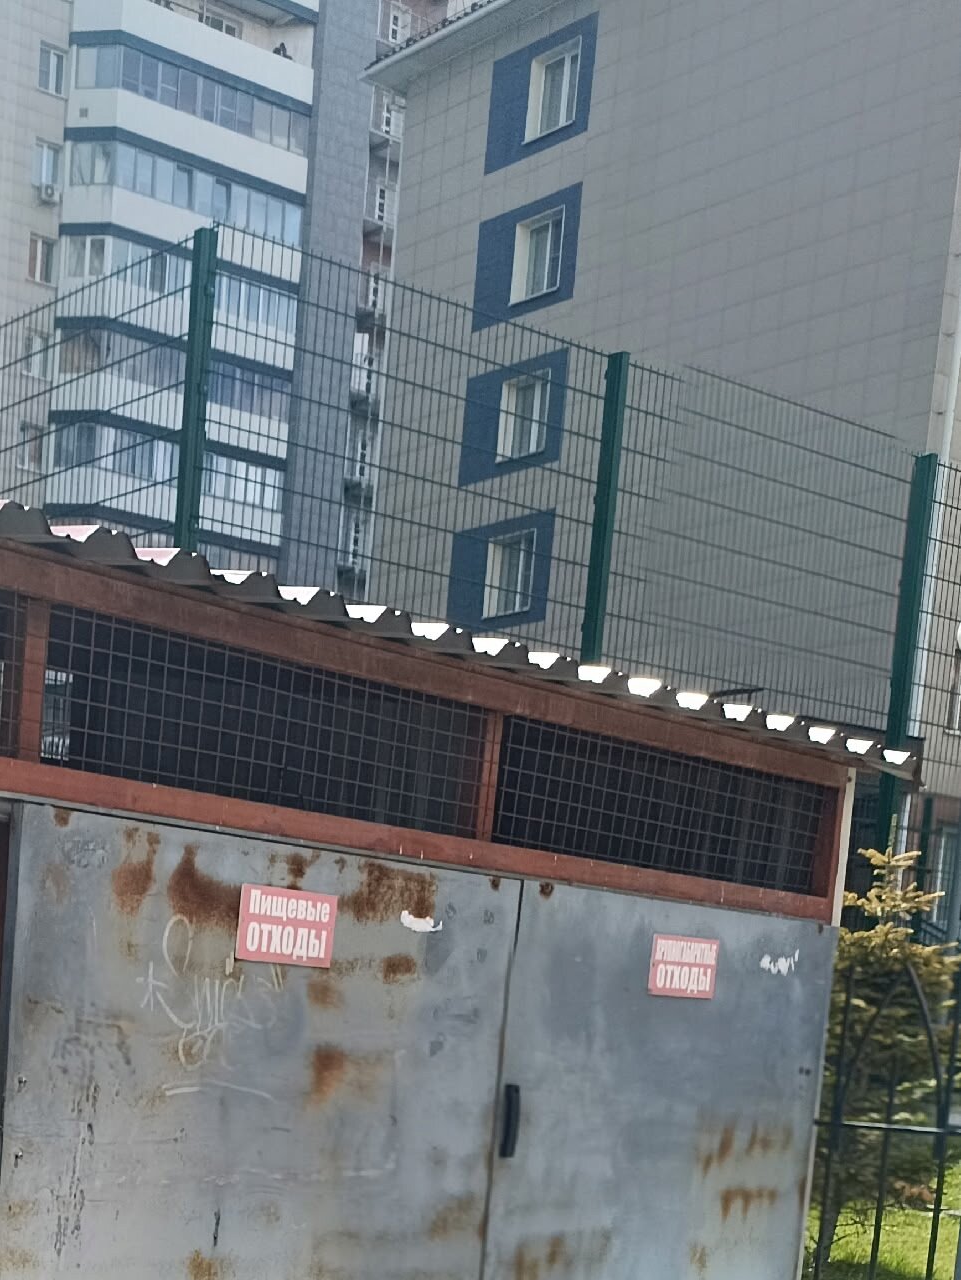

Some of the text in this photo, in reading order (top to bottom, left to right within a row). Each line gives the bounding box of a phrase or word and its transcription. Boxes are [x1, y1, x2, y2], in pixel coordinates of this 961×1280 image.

[248, 888, 331, 923] Пищевые
[245, 921, 328, 962] ОТХОДЫ
[656, 963, 712, 994] ОТХОДЫ
